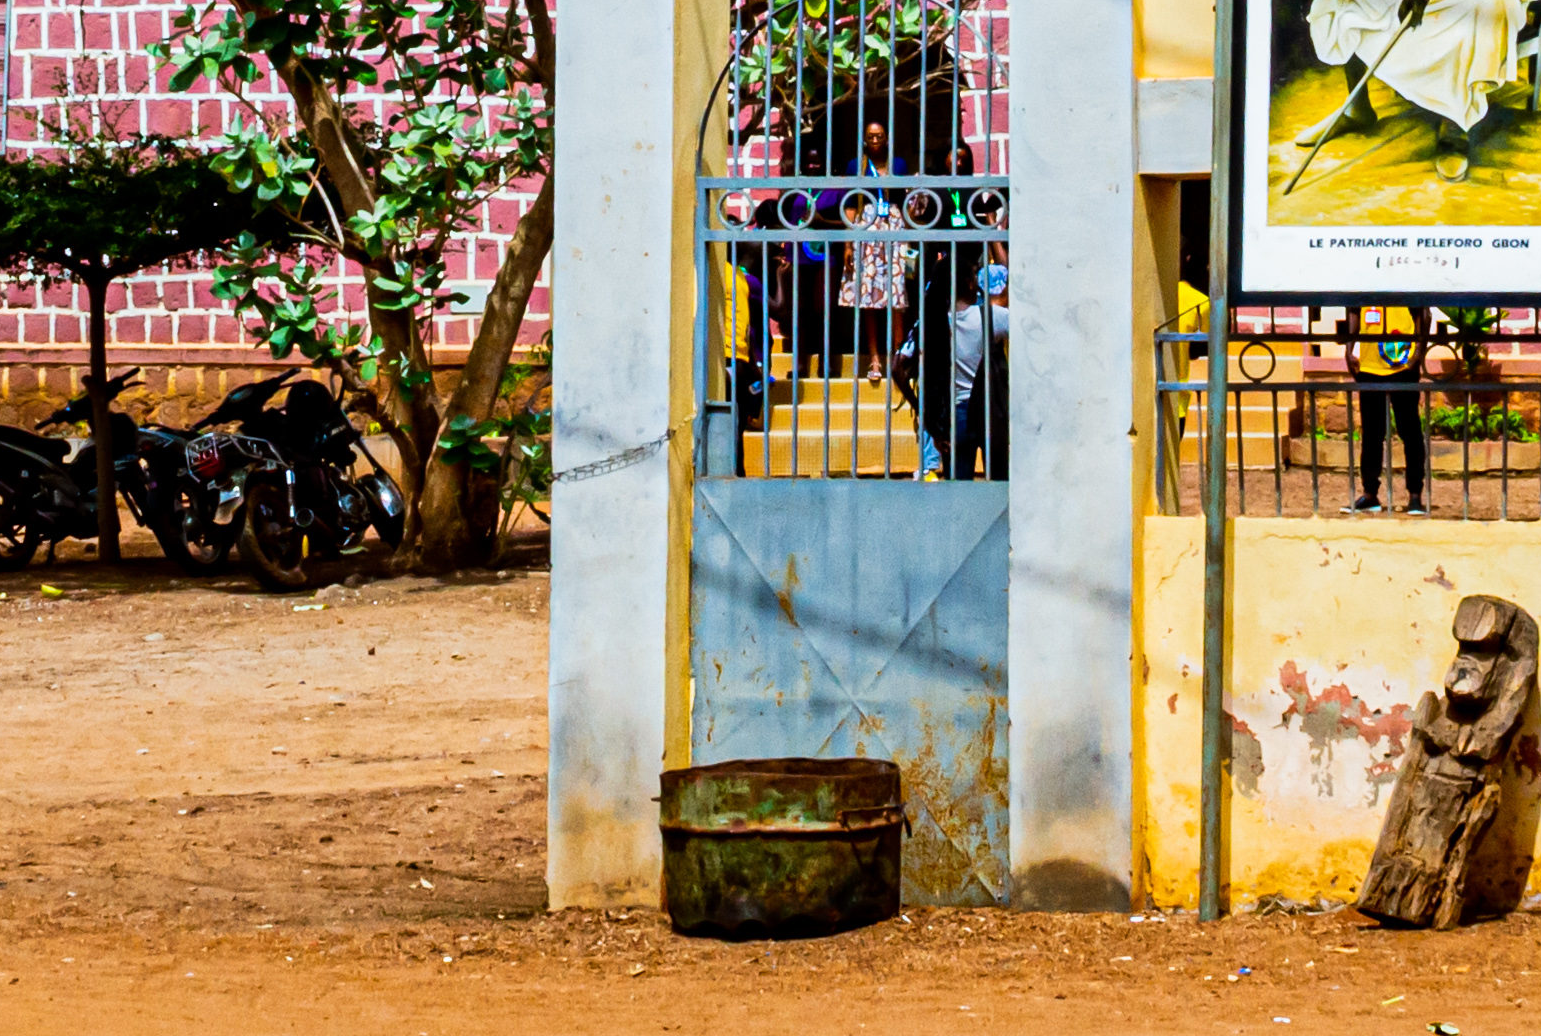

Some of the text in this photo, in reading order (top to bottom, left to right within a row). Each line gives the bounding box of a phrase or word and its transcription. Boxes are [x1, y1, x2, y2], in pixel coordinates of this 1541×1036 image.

[1309, 238, 1530, 250] LE PATRIARCHE PELEFORO GBON
